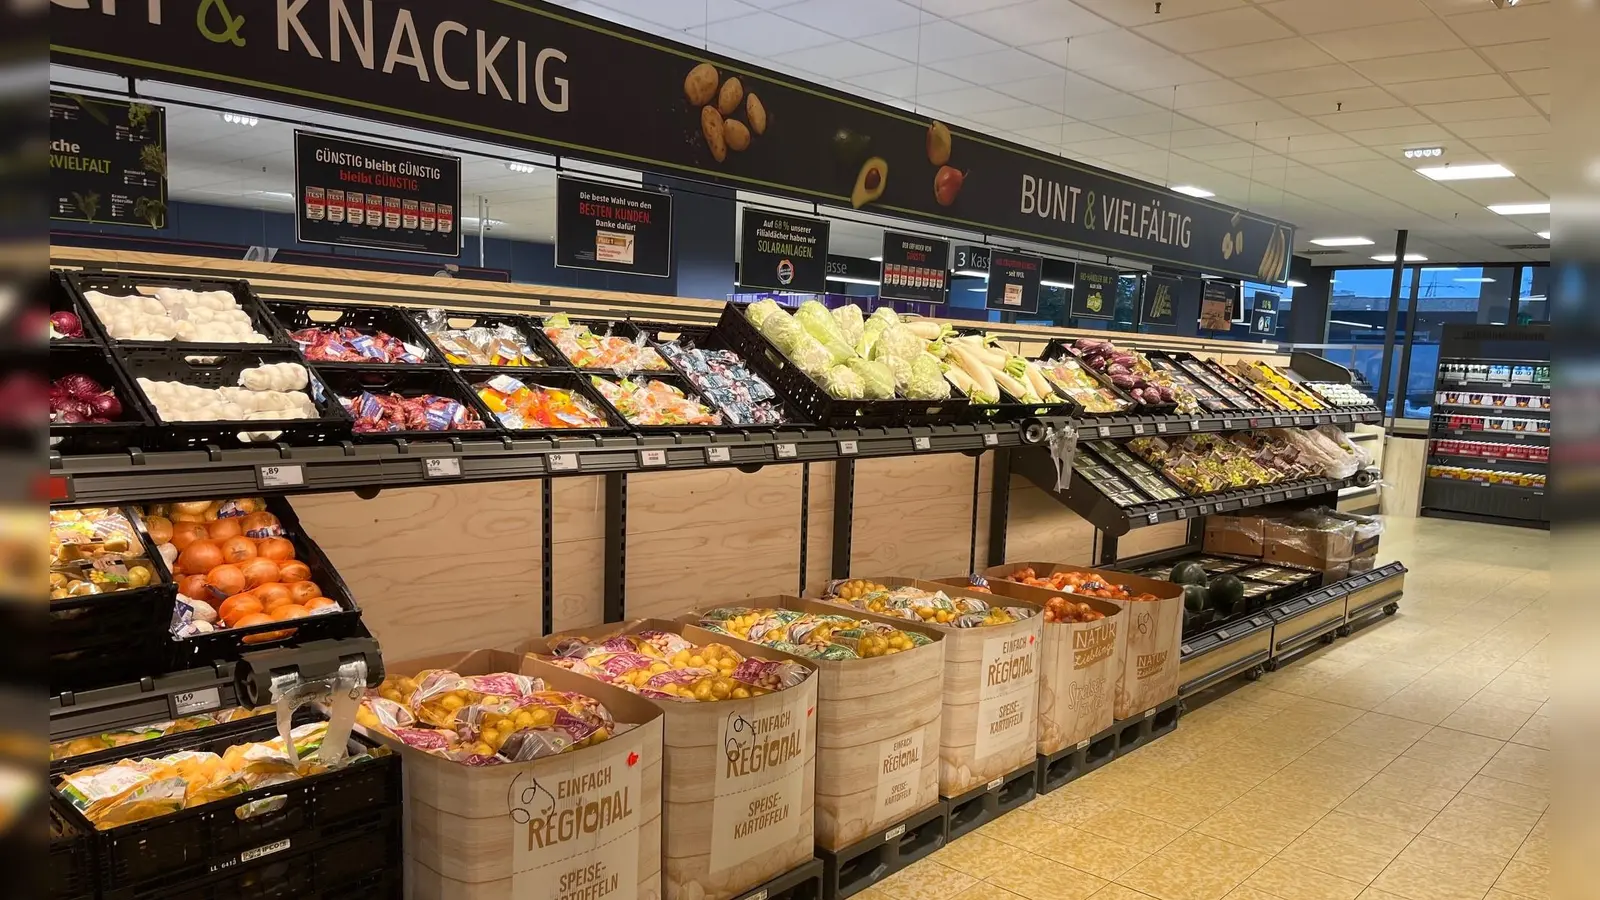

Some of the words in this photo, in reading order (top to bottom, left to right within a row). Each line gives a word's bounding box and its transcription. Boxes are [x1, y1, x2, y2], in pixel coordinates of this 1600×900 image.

[277, 0, 569, 113] KNACKIG
[50, 139, 80, 153] che
[316, 148, 362, 168] GÜNSTIG
[364, 158, 396, 174] bleibt
[398, 161, 440, 180] GÜNSTIG
[340, 170, 372, 186] bleibt
[374, 173, 420, 192] GÜNSTIG.
[580, 192, 591, 200] Die
[592, 194, 610, 203] beste
[610, 196, 626, 206] Wahl
[627, 200, 638, 208] von
[640, 200, 652, 210] den
[1020, 174, 1081, 224] BUNT
[1084, 190, 1096, 231] &
[1102, 194, 1192, 249] VIELFÄLTIG
[580, 202, 612, 219] BESTEN
[614, 208, 652, 224] KUNDEN.
[596, 219, 616, 229] Danke
[617, 221, 636, 231] dafür!
[756, 228, 789, 240] Filialdächer
[789, 233, 806, 243] haben
[808, 236, 817, 244] wir
[763, 220, 774, 228] Auf
[774, 220, 782, 229] 68
[783, 220, 790, 231] %
[790, 225, 812, 234] unserer
[758, 240, 814, 259] SOLARANLAGEN.
[957, 252, 966, 267] 3
[971, 252, 990, 268] Kass
[826, 262, 848, 274] asse
[262, 467, 279, 476] -,89
[1003, 637, 1027, 654] EINFACH
[1076, 622, 1117, 649] NATUR
[987, 652, 1032, 686] REGIONAL
[176, 693, 193, 703] 1,69
[999, 700, 1020, 718] SPEISE-
[752, 710, 791, 735] EINFACH
[990, 712, 1023, 735] KARTOFFELN
[726, 728, 801, 778] REGIONAL
[883, 747, 919, 774] REGIONAL
[558, 766, 612, 800] EINFACH
[748, 792, 782, 817] SPEISE-
[528, 786, 632, 851] REGIONAL
[734, 803, 790, 839] KARTOFFELN
[560, 861, 606, 892] SPEISE-
